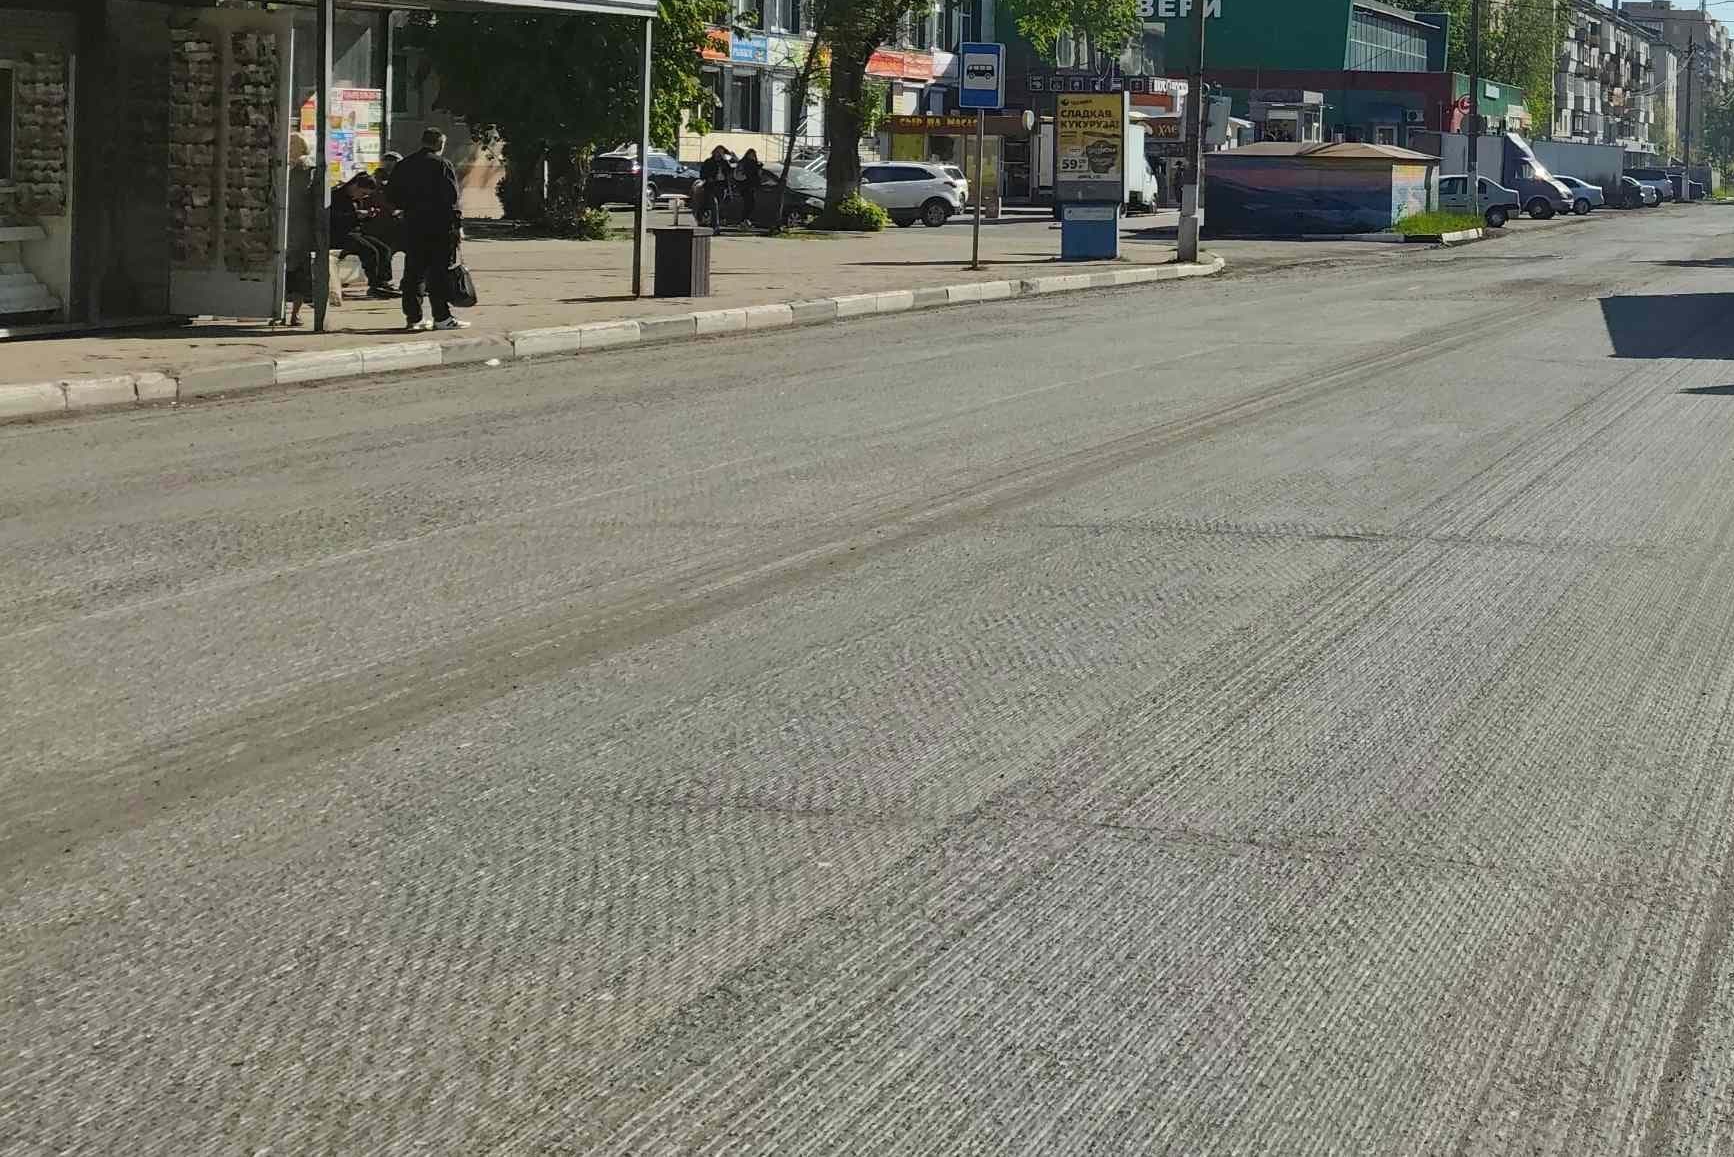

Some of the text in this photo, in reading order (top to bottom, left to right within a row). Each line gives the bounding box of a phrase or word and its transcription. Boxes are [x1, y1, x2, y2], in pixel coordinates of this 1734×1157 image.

[1060, 109, 1113, 119] СЛАДКАЯ
[1060, 120, 1120, 130] КУКУРУЗА!
[1061, 158, 1078, 170] 59
